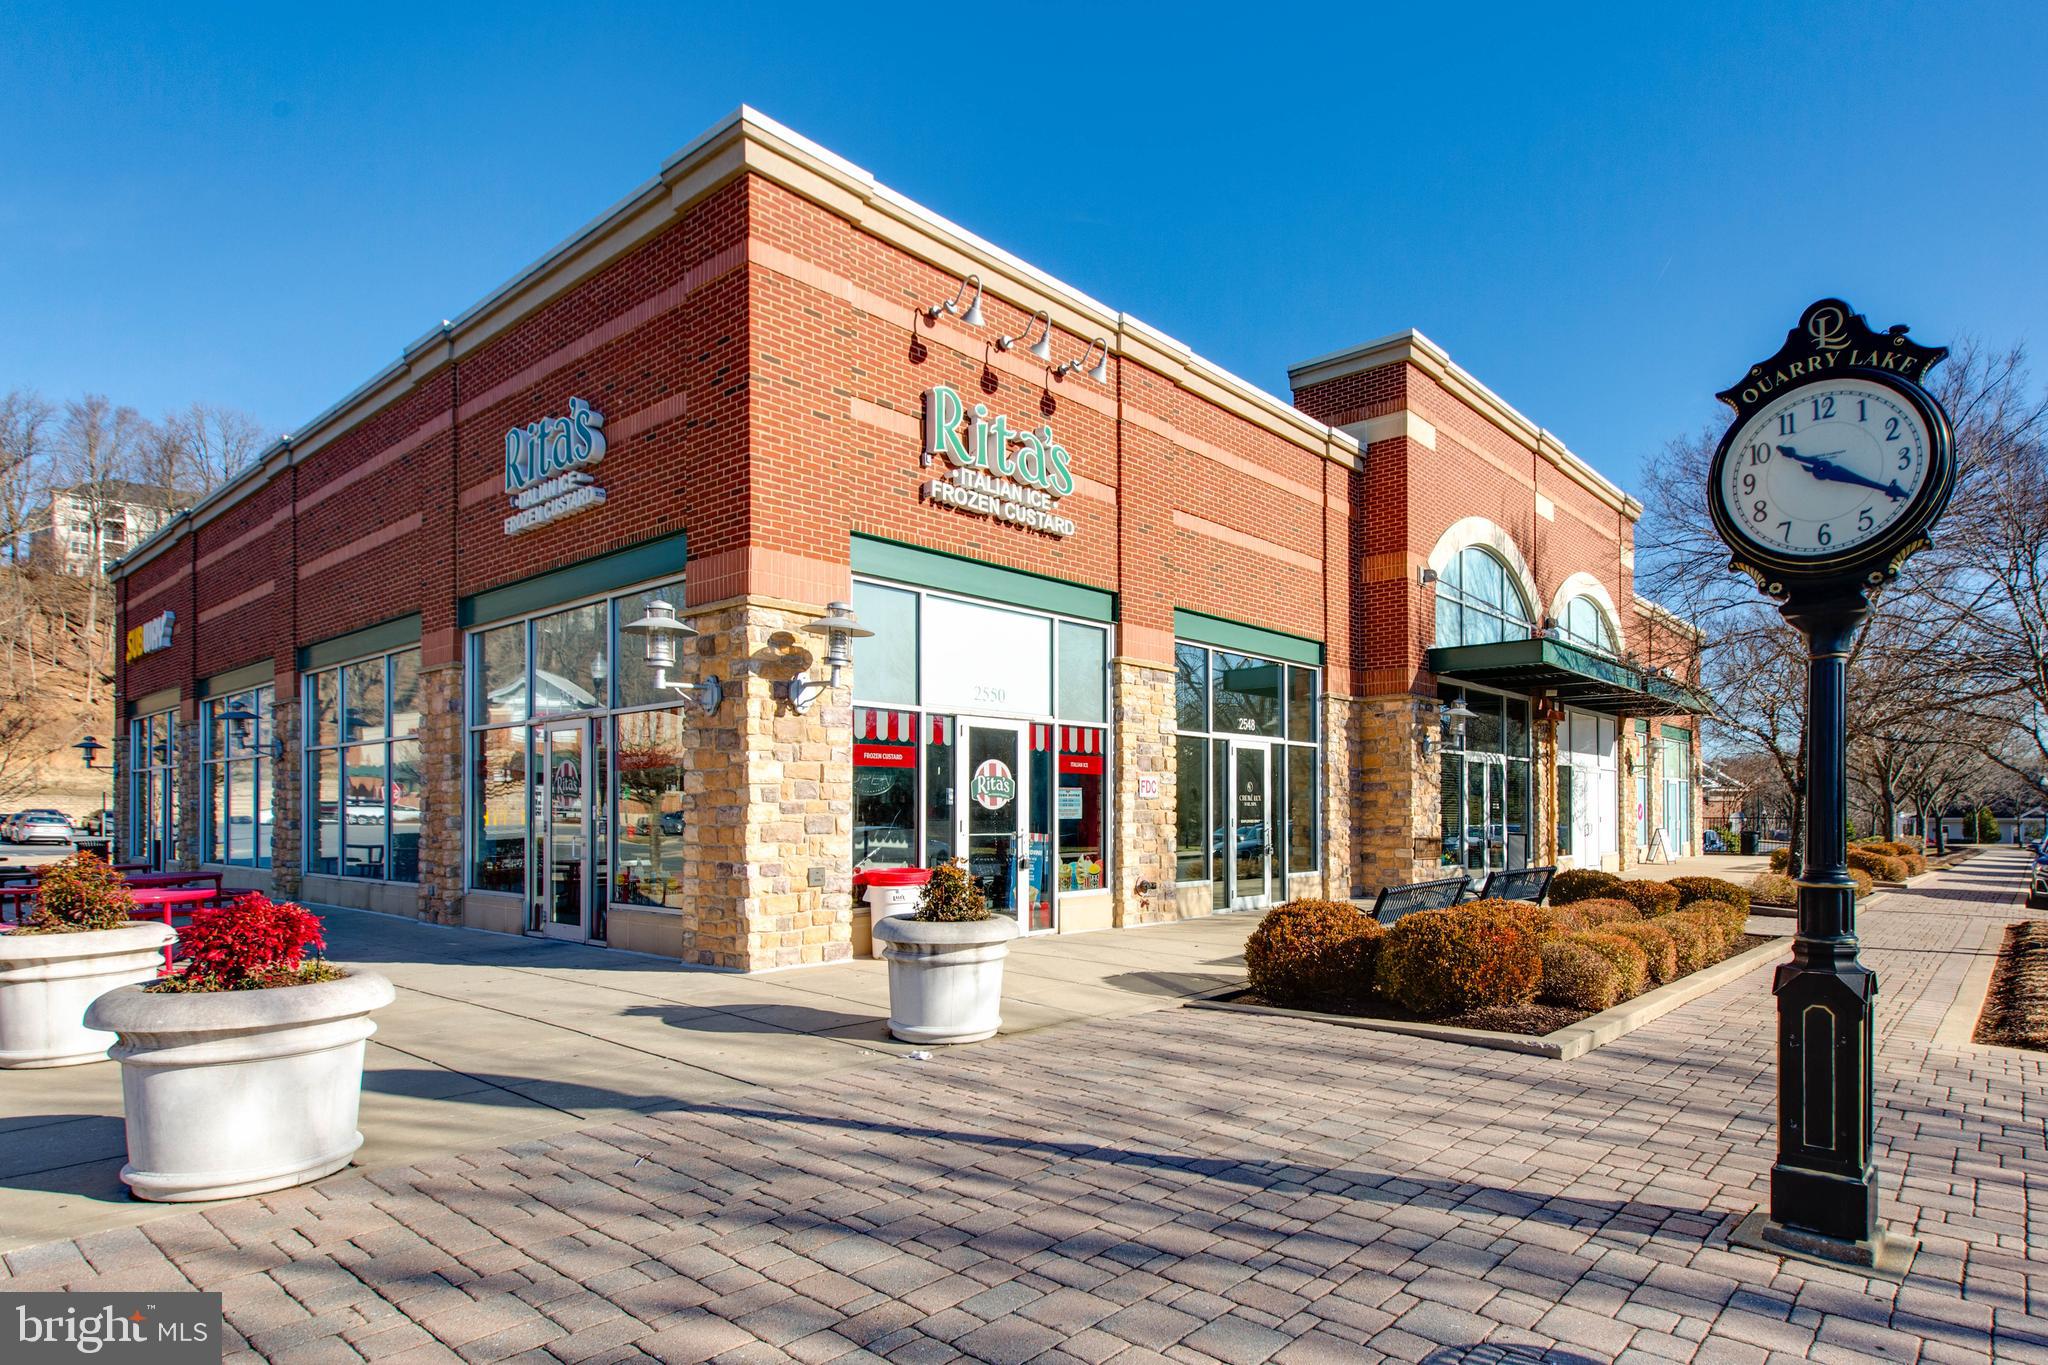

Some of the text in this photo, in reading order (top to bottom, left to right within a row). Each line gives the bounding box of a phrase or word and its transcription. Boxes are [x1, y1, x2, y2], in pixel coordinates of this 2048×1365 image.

[1742, 350, 1919, 404] QUARRY LAKE
[1812, 396, 1836, 421] 12
[1857, 399, 1867, 422] 1
[1778, 414, 1795, 436] 11
[1885, 417, 1901, 441] 2
[505, 396, 595, 493] Rita's
[933, 386, 1074, 496] Rita's
[1750, 443, 1771, 465] 10
[1898, 447, 1911, 470] 3
[960, 468, 1051, 509] ITALIAN ICE
[1743, 473, 1756, 495] 9
[504, 485, 594, 535] FROZEN CUSTARD
[931, 480, 1075, 536] FROZEN CUSTARD
[1753, 500, 1767, 523] 8
[1857, 506, 1873, 531] 5
[1776, 521, 1791, 543] 7
[1817, 523, 1831, 546] 6
[126, 610, 171, 664] SUBWAY
[974, 685, 1006, 703] 2550
[1238, 718, 1256, 731] 2548
[864, 752, 882, 760] FROZEN
[557, 775, 578, 795] Rita's
[977, 775, 1010, 794] Rita's
[1140, 779, 1157, 794] FDC
